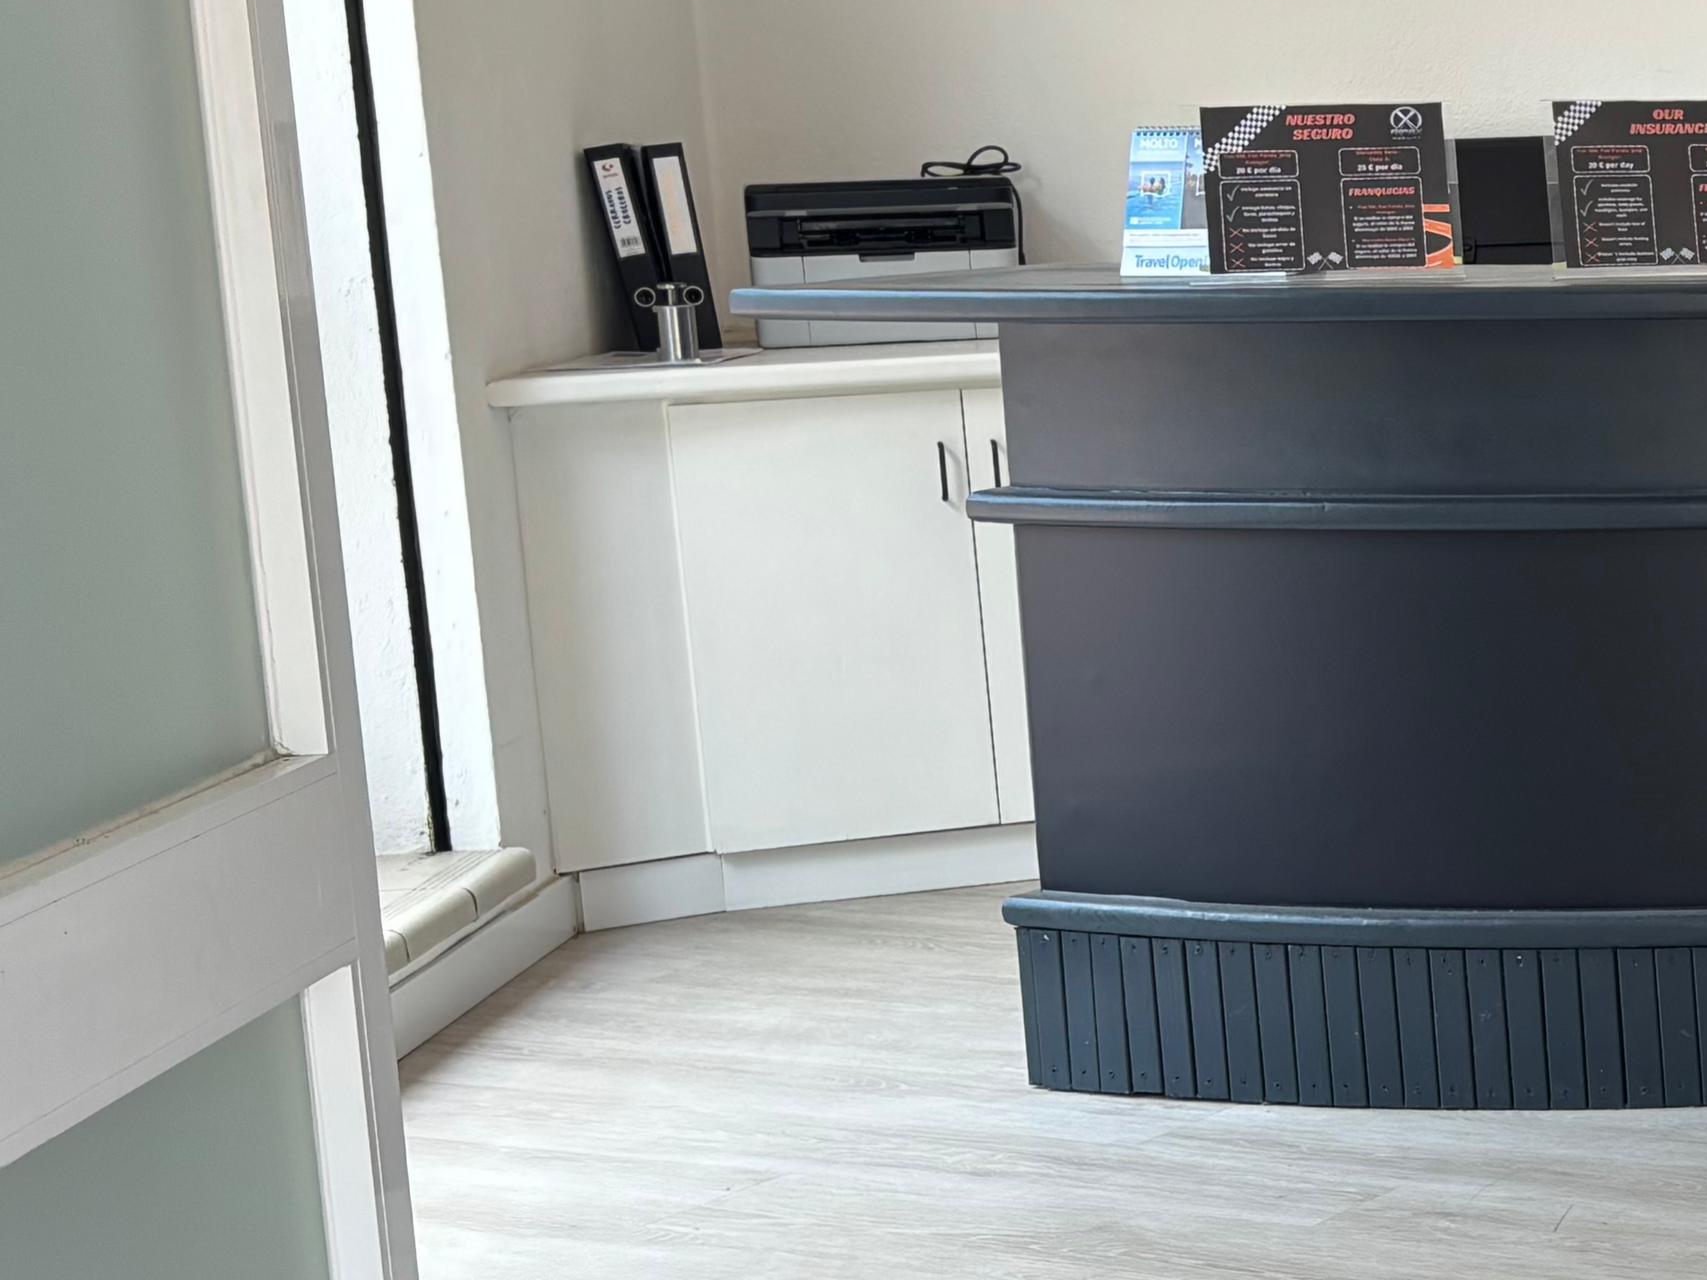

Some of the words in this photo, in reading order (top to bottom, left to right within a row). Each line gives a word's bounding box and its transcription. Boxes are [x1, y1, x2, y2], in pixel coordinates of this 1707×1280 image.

[1285, 114, 1356, 126] NUESTRO
[1652, 108, 1684, 120] OUR
[1293, 128, 1354, 141] SEGURO
